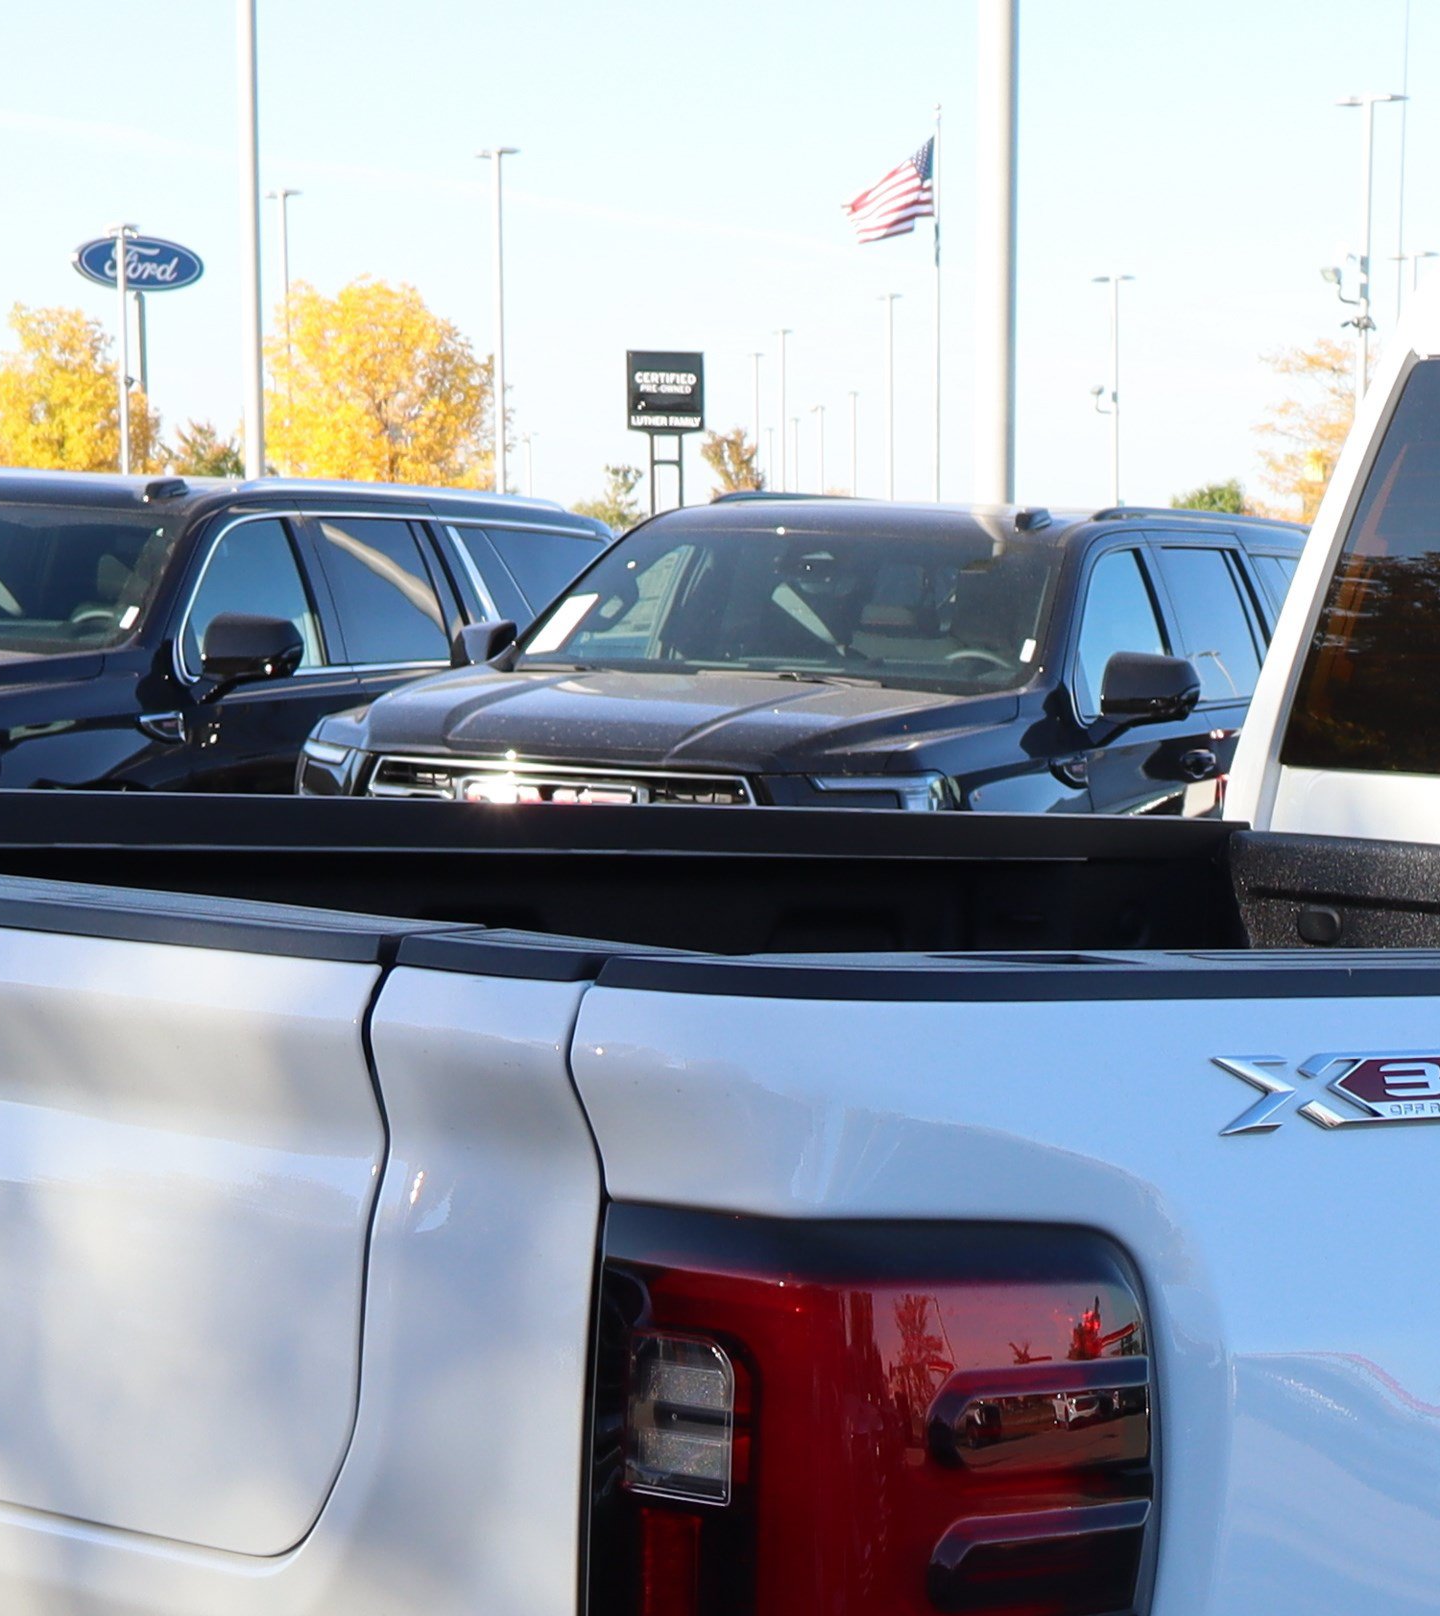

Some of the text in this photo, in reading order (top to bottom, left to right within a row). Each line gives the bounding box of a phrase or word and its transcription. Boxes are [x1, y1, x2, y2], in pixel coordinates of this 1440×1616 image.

[103, 244, 179, 281] Ford
[634, 371, 697, 385] CERTIFIED
[640, 384, 692, 394] PRE-OWNED
[630, 415, 701, 428] LUTHER FAMILY
[1389, 1104, 1425, 1117] OFF
